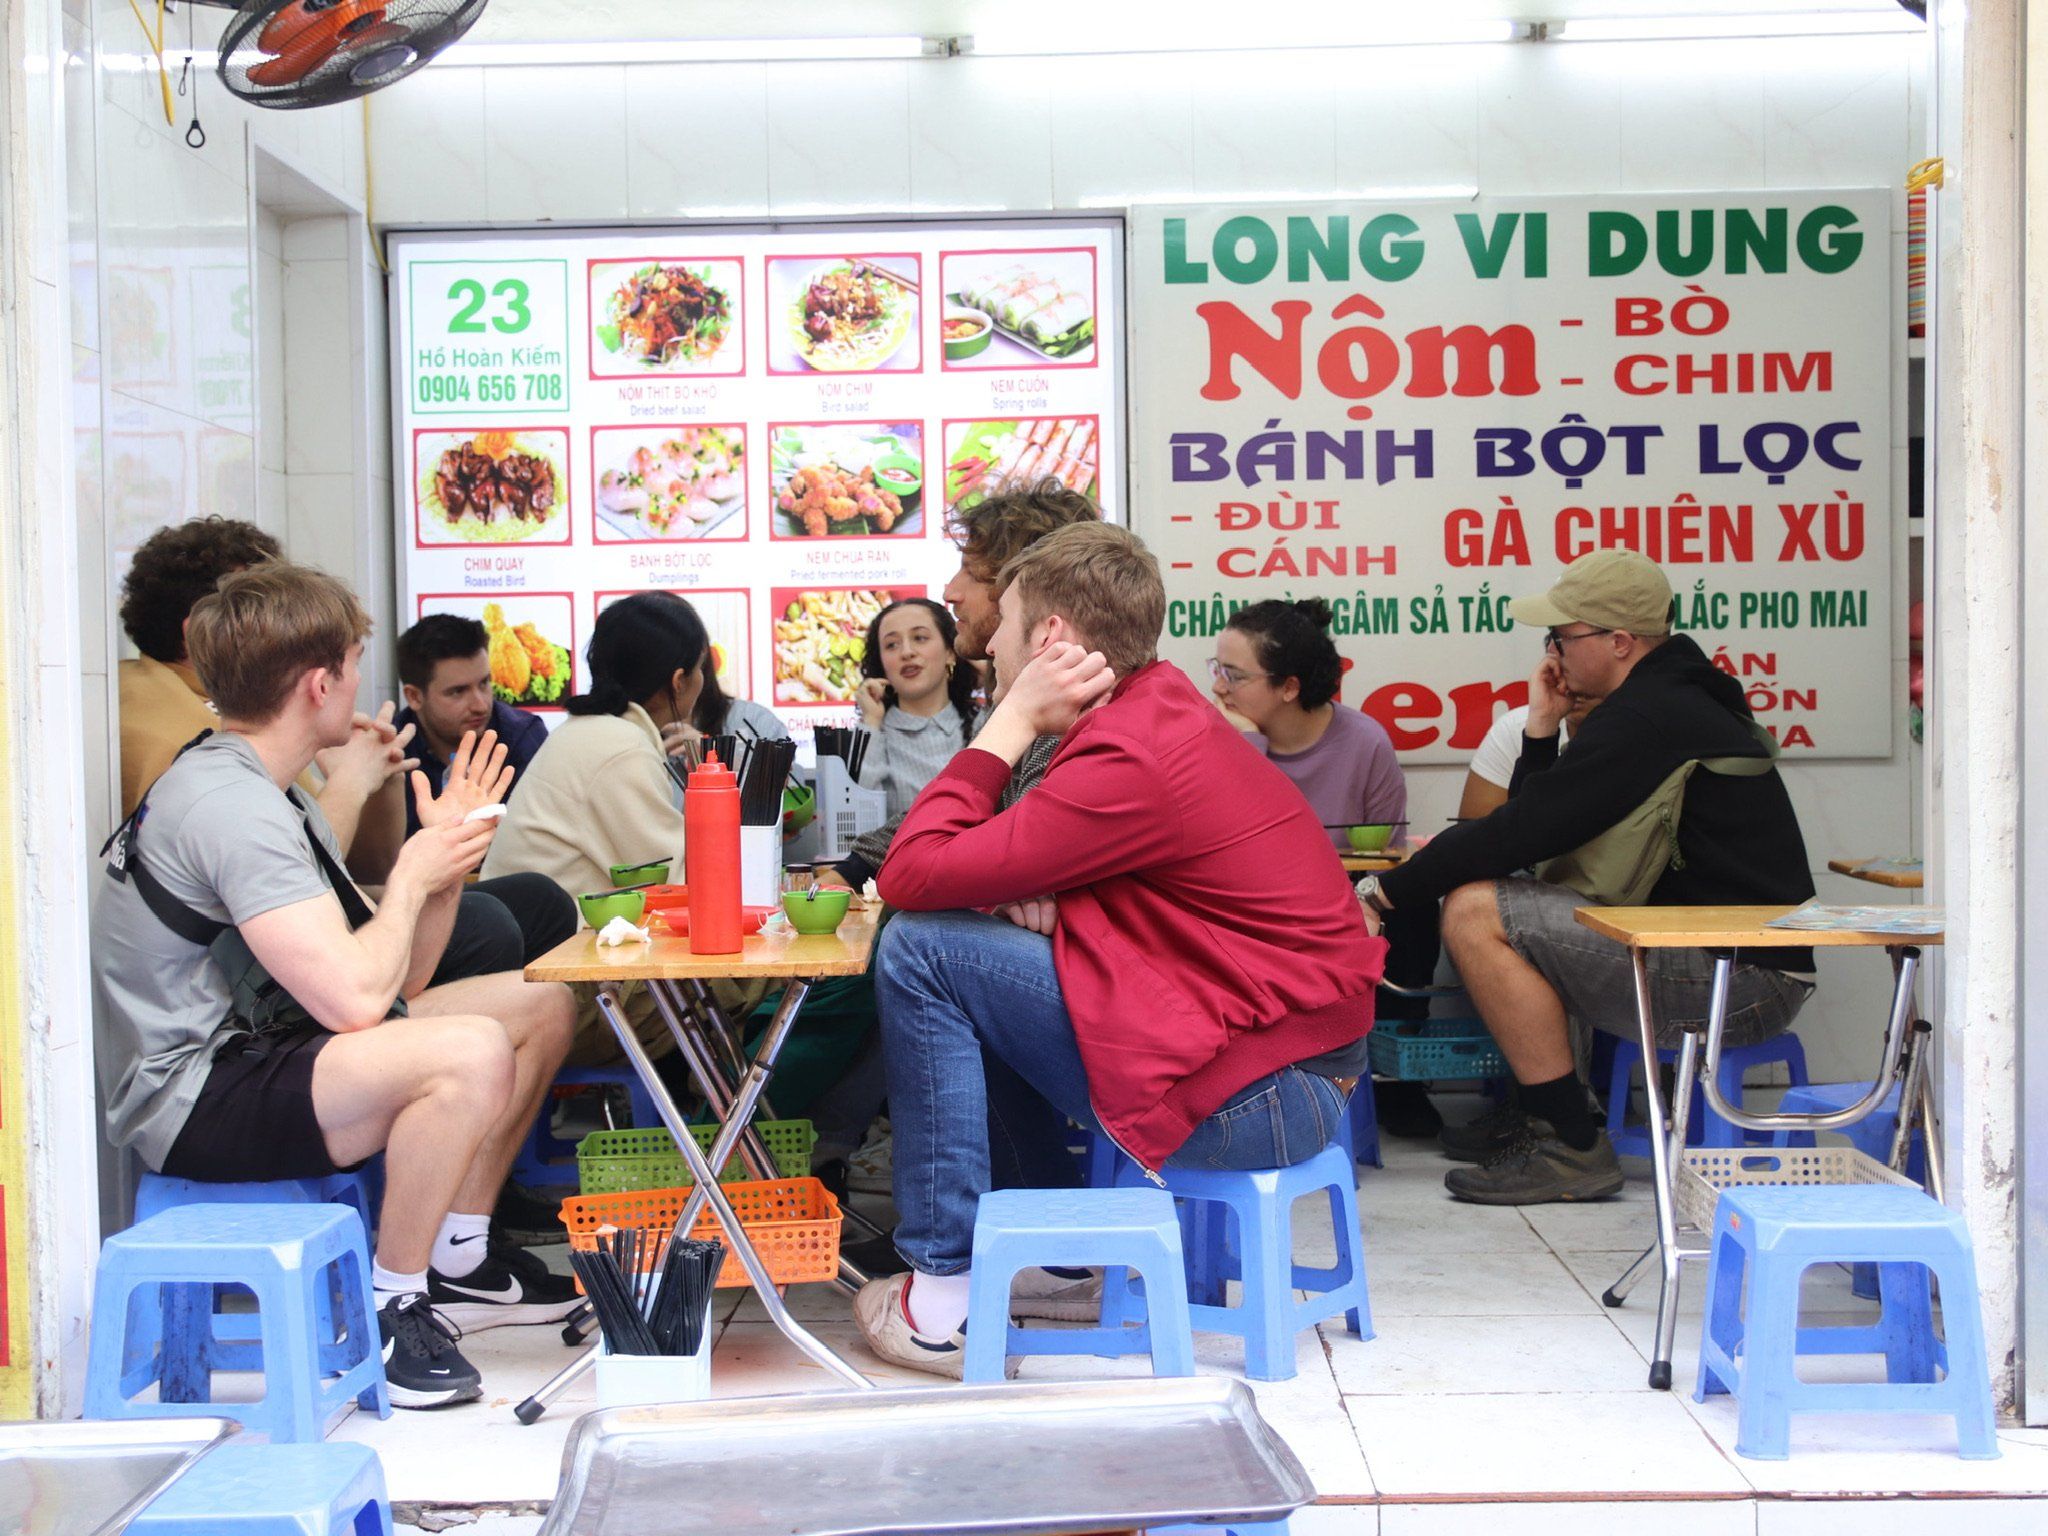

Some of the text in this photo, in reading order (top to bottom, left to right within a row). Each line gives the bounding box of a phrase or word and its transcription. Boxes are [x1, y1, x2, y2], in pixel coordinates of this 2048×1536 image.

[1163, 206, 1864, 285] LONG VI DUNG
[447, 279, 531, 334] 23
[453, 347, 503, 368] Hoàn
[511, 343, 562, 366] Kiếm
[1196, 293, 1541, 421] Nộm
[1615, 285, 1730, 337] BÒ
[1614, 351, 1833, 396] CHIM
[418, 373, 562, 403] 0904 656 708
[992, 396, 1048, 412] Spring rolls
[1169, 413, 1863, 490] BÁNH BỘT LỌC
[1214, 491, 1341, 531] ĐÙI
[1444, 490, 1865, 567] GÀ CHIÊN XÙ
[464, 556, 524, 572] CHIM QUAY
[648, 571, 700, 585] Dumplings
[1216, 537, 1397, 579] CÁNH
[464, 574, 525, 587] Roasted Bird
[1410, 584, 1449, 634] SẢ
[1458, 581, 1514, 633] TẮC
[1674, 578, 1729, 630] LẮC
[1740, 591, 1799, 629] PHO
[1810, 590, 1868, 627] MAI
